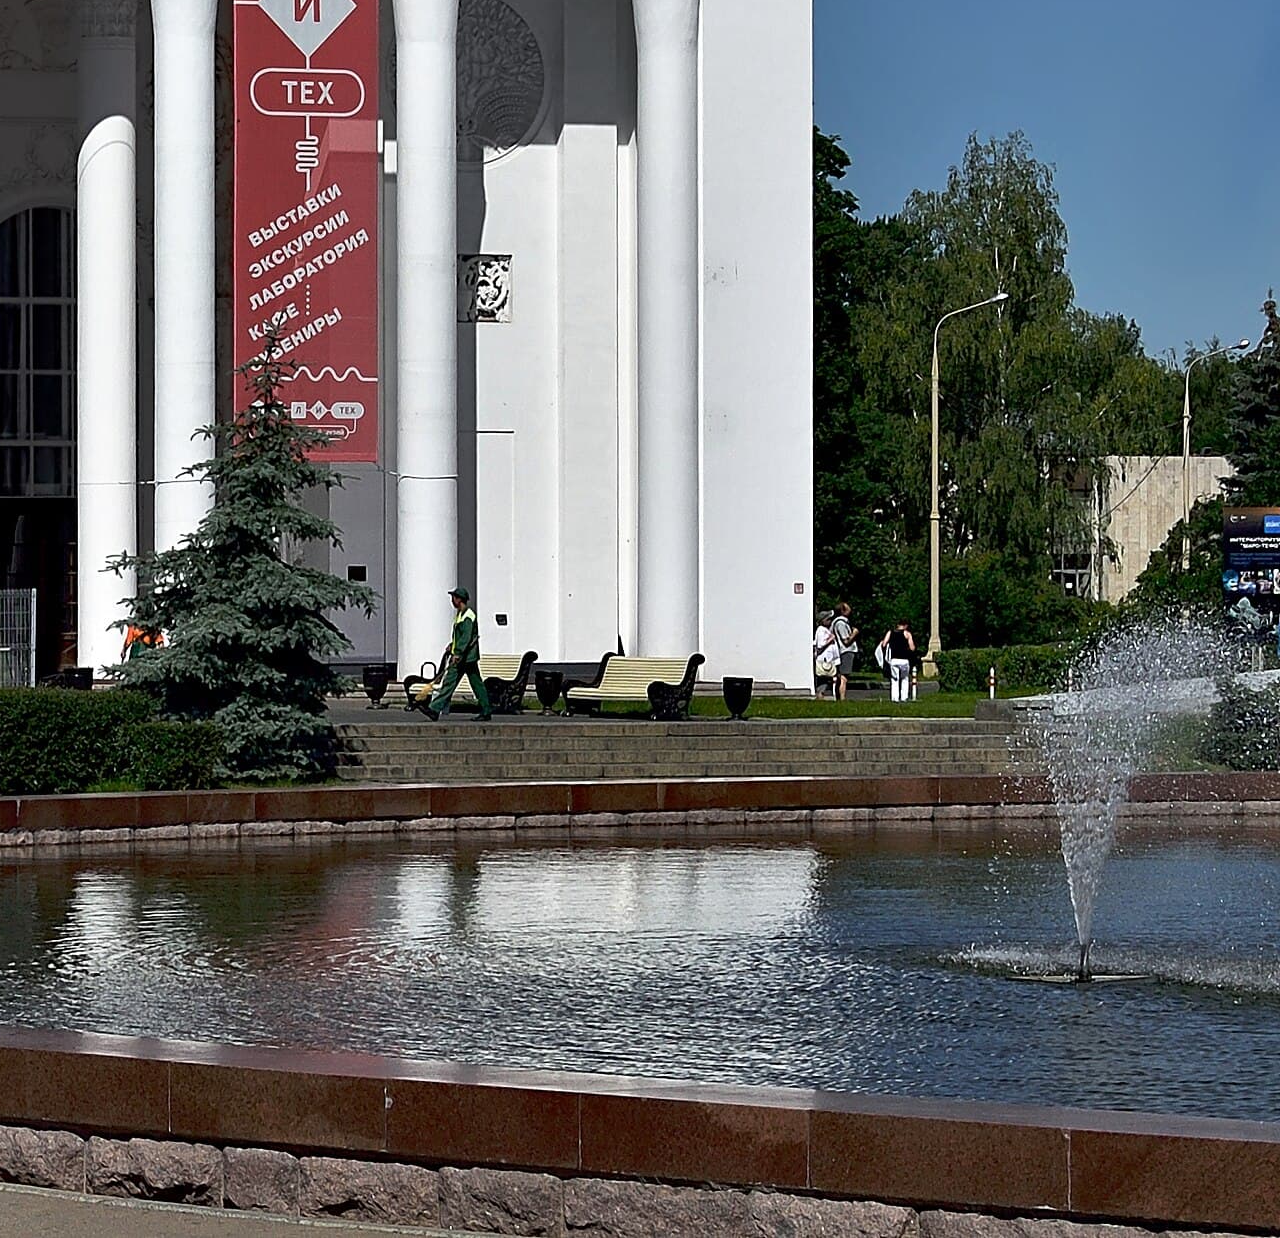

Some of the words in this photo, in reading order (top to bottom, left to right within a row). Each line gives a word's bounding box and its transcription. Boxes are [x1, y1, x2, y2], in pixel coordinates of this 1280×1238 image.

[281, 80, 334, 105] ТЕХ
[248, 183, 342, 248] ВЫСТАВКИ
[248, 209, 350, 279] ЭКСКУРСИИ
[249, 228, 370, 311] ЛАБОРАТОРИЯ
[248, 302, 300, 341] КАФЕ
